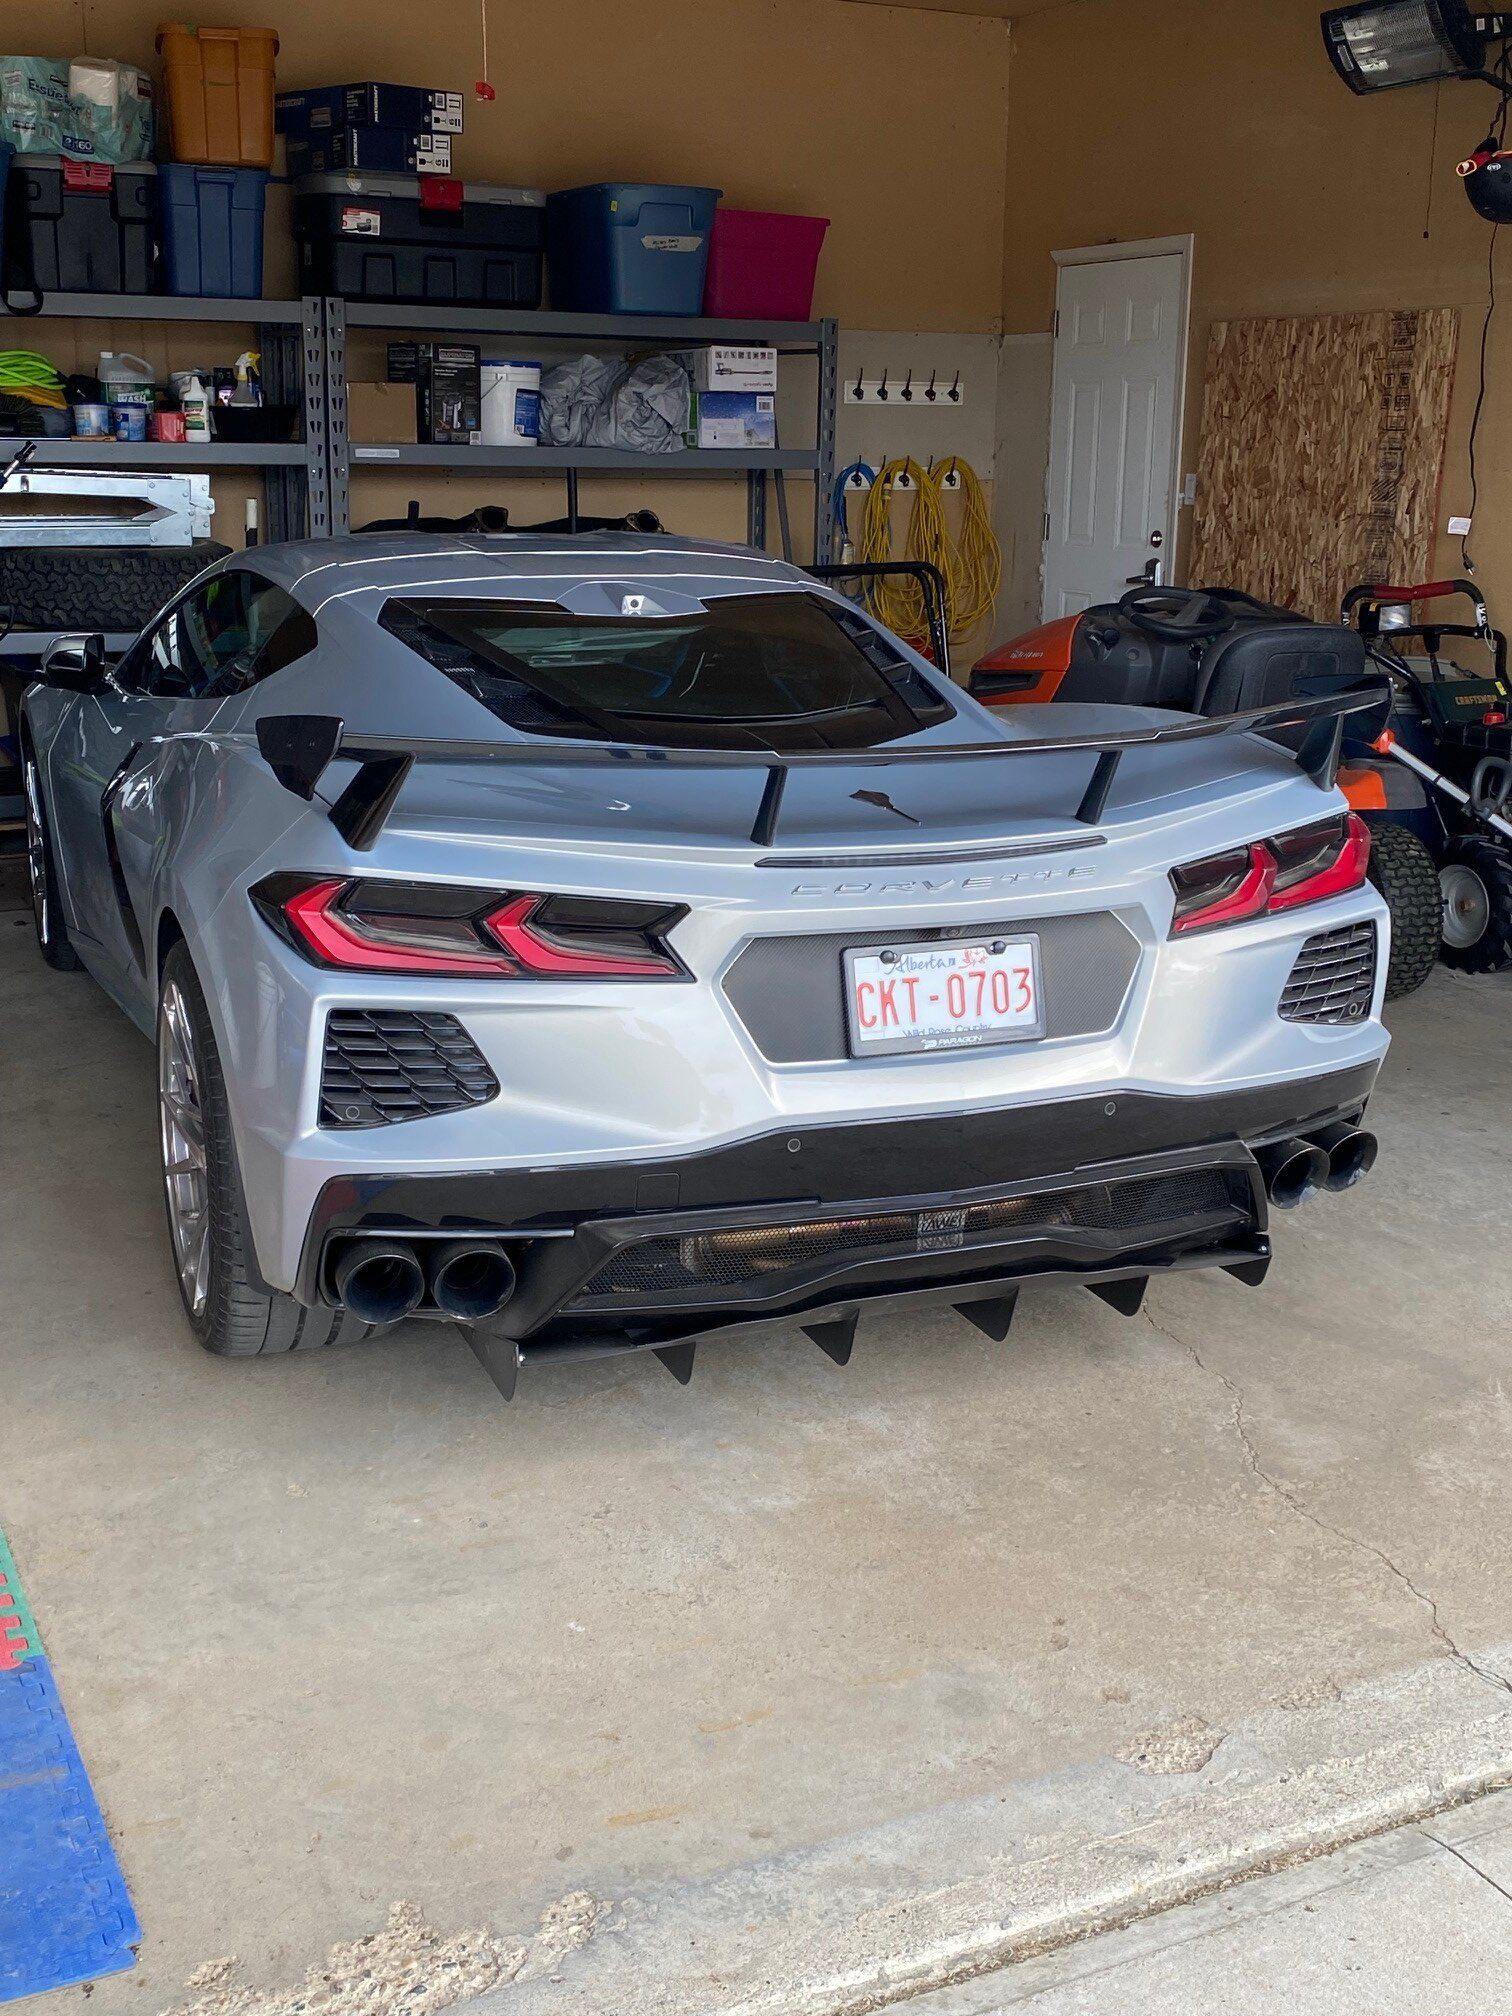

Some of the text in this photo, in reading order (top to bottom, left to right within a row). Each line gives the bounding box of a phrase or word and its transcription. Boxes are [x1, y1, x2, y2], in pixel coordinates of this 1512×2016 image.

[791, 865, 1098, 896] CORVETTE
[884, 954, 946, 975] Alberta
[856, 966, 1032, 1029] CKT-0703
[938, 1035, 983, 1046] PARAGON
